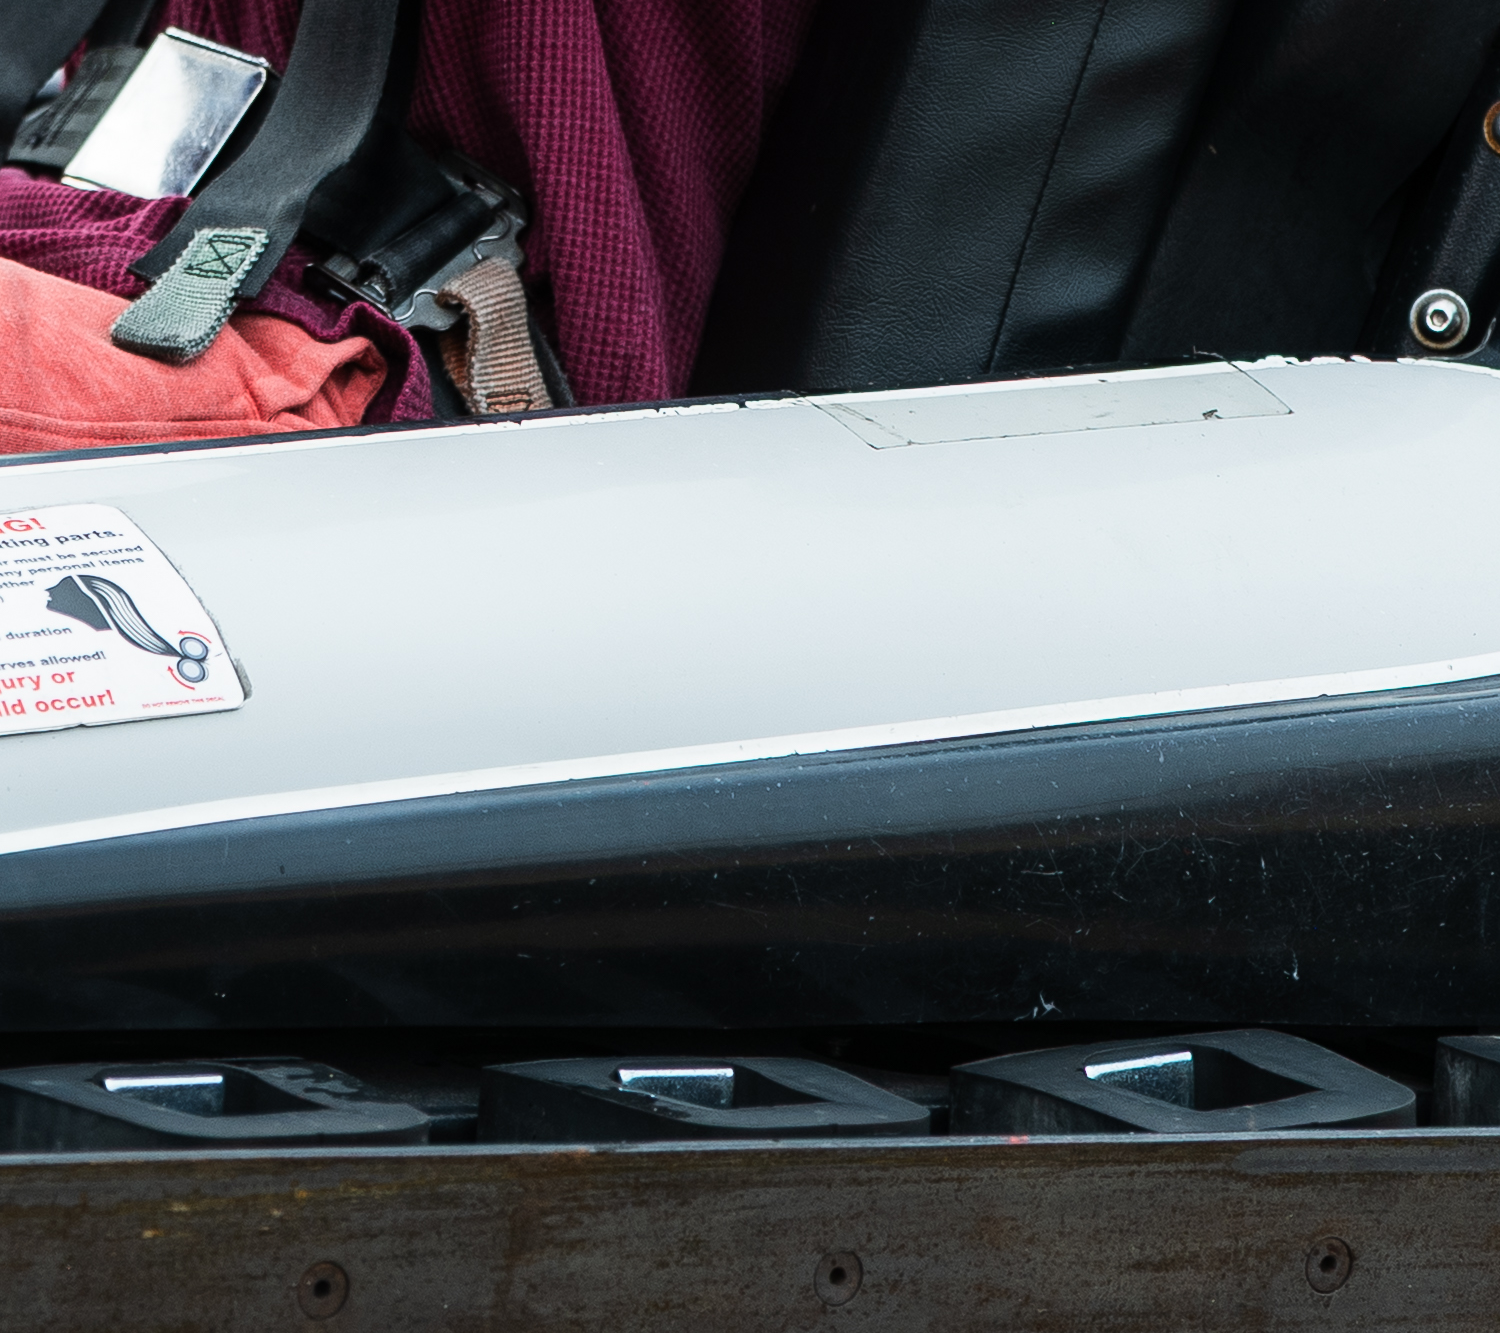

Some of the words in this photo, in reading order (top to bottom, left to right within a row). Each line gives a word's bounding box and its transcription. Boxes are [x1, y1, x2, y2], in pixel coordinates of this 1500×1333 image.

[54, 529, 125, 545] parts.
[13, 553, 54, 564] must
[57, 551, 77, 560] be
[80, 544, 144, 558] secured
[28, 560, 97, 576] personal
[99, 556, 145, 568] items
[5, 624, 73, 641] duration
[40, 650, 107, 667] allowed!
[50, 669, 77, 684] or
[35, 688, 116, 713] occur!
